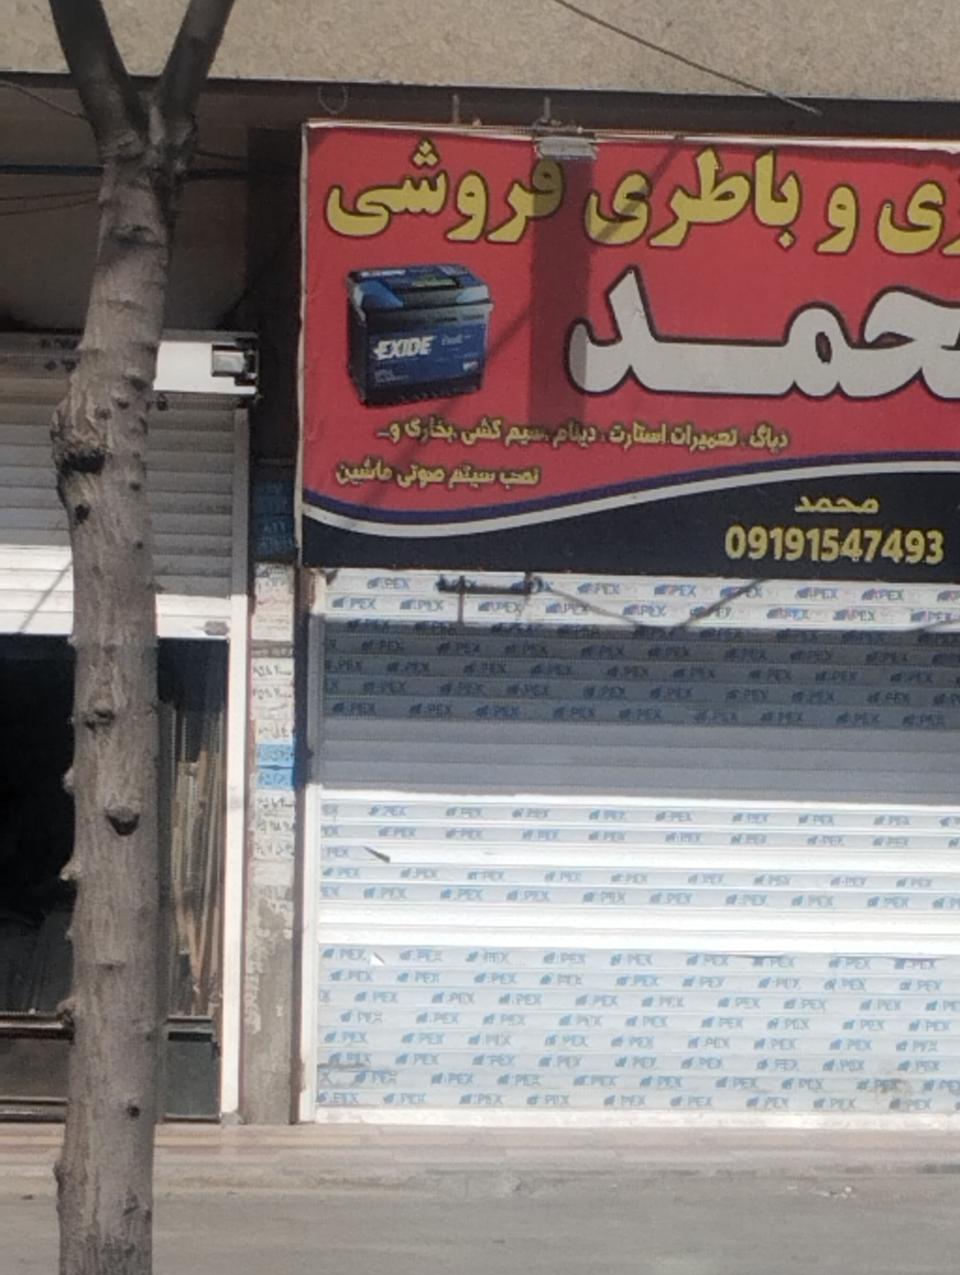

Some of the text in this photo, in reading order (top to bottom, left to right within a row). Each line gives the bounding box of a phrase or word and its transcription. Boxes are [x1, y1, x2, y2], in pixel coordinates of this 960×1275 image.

[325, 139, 565, 243] فروشی
[584, 147, 802, 249] باطری
[815, 185, 860, 255] و
[373, 336, 436, 361] EXIDE
[609, 422, 666, 449] استارت
[670, 424, 738, 452] تعمیرات
[336, 456, 393, 484] ماشین
[397, 465, 445, 488] صوتی
[499, 467, 540, 489] نصب
[794, 495, 880, 514] محمد
[723, 523, 945, 564] 09191547493
